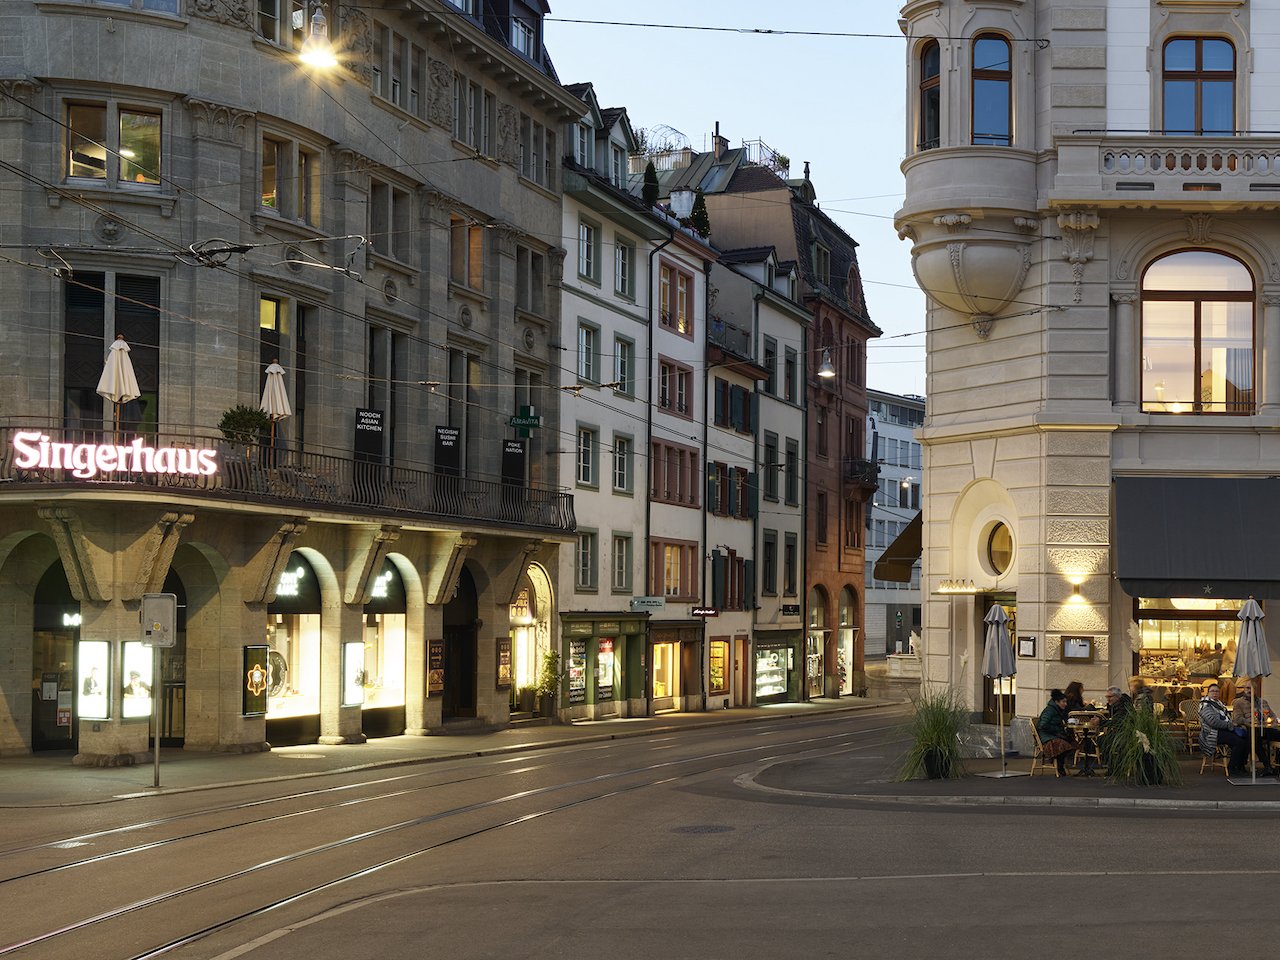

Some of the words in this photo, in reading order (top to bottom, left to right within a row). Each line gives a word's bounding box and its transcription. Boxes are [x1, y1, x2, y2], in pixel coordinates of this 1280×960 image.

[359, 411, 382, 419] NOOCH
[356, 424, 383, 432] KITCHEN
[437, 428, 459, 436] NEGISHI
[14, 431, 217, 478] Singerhaus
